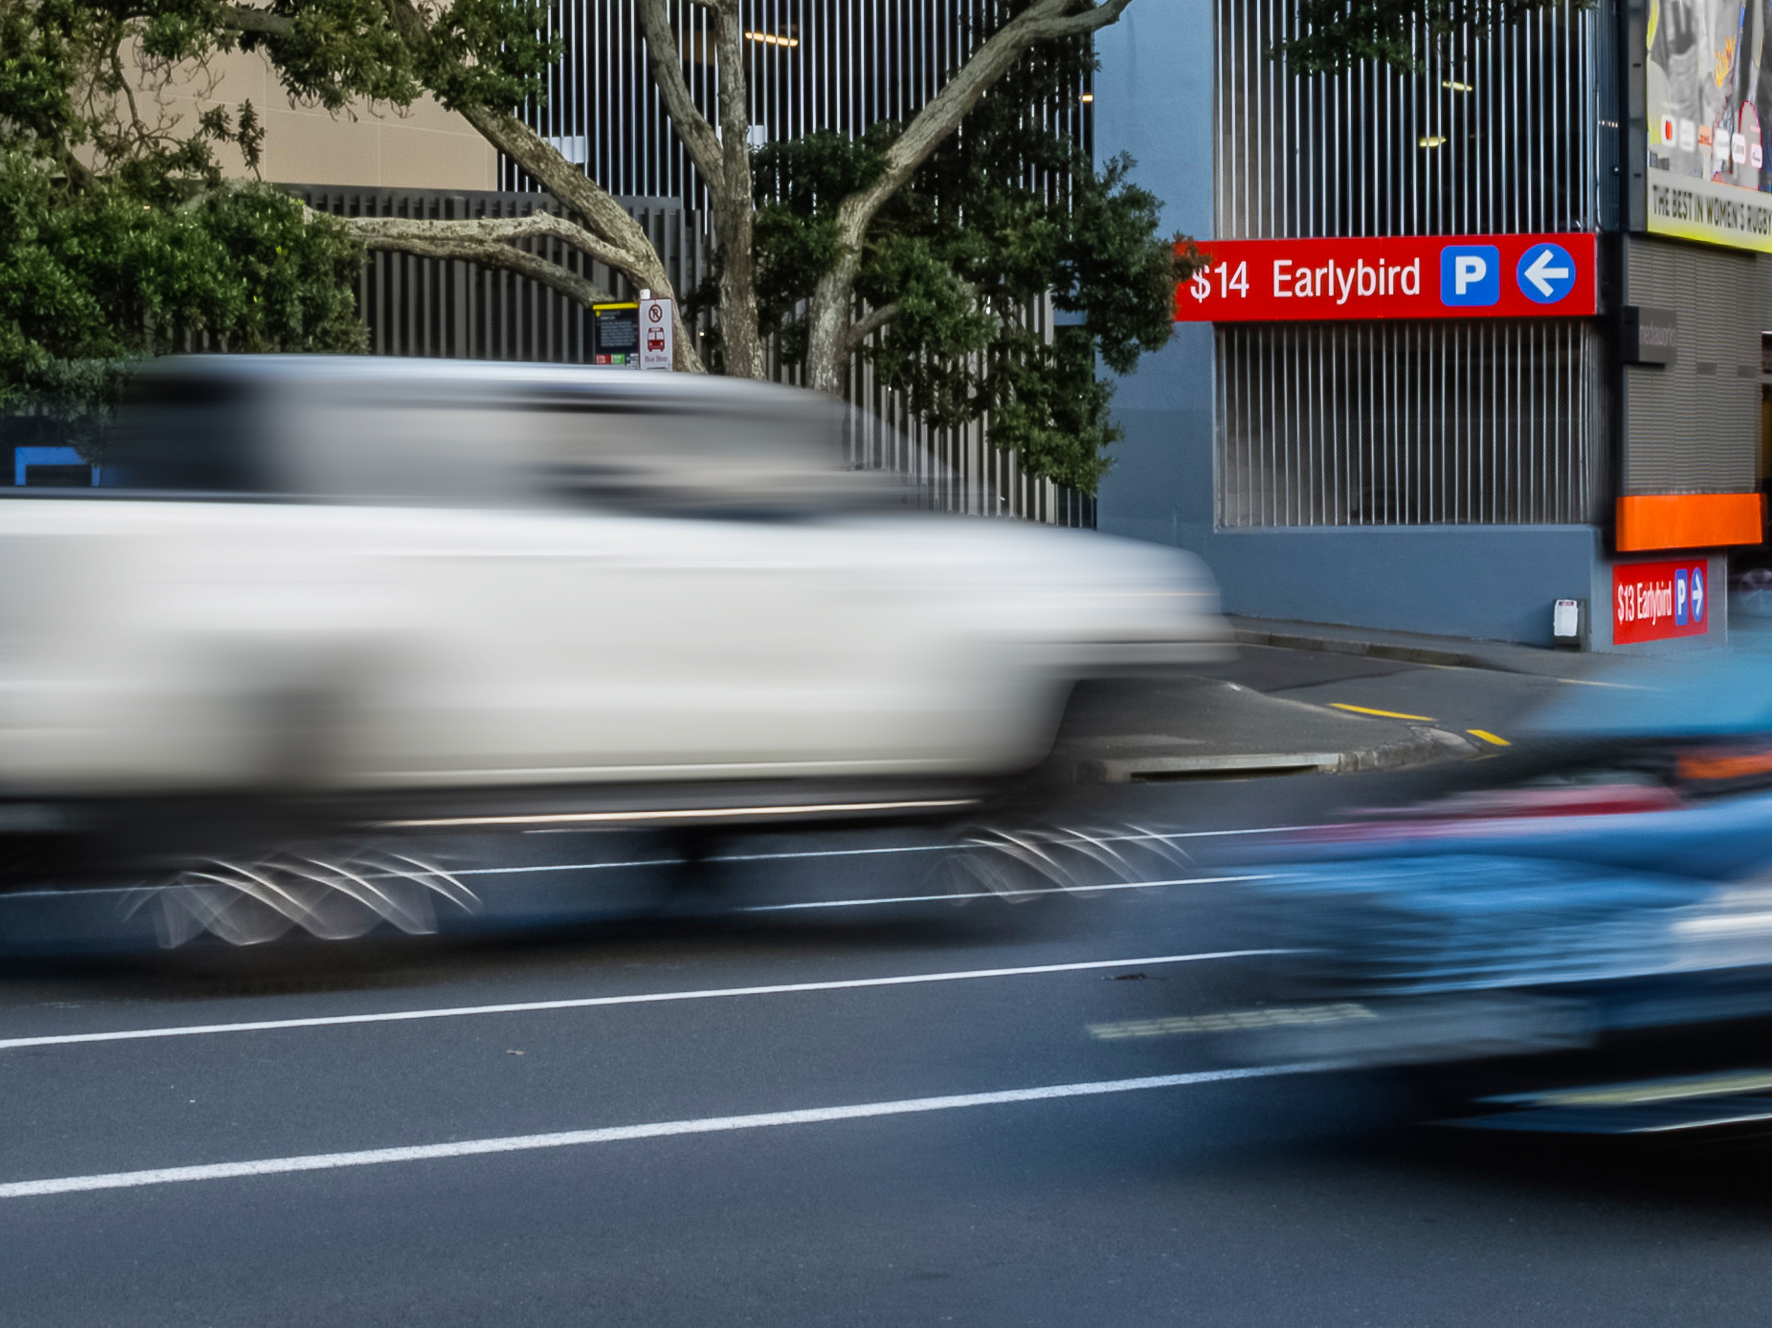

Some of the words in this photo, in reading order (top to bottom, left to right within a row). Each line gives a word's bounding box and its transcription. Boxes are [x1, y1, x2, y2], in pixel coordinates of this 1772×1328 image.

[1652, 184, 1670, 217] THE
[1672, 187, 1693, 222] BEST
[1695, 193, 1704, 224] IN
[1706, 195, 1745, 231] WOMEN'S
[1747, 204, 1772, 237] RUGBY
[1190, 261, 1250, 304] $14
[1273, 257, 1421, 305] Earlybird
[1617, 584, 1635, 625] $13
[1637, 580, 1673, 626] Earlybird
